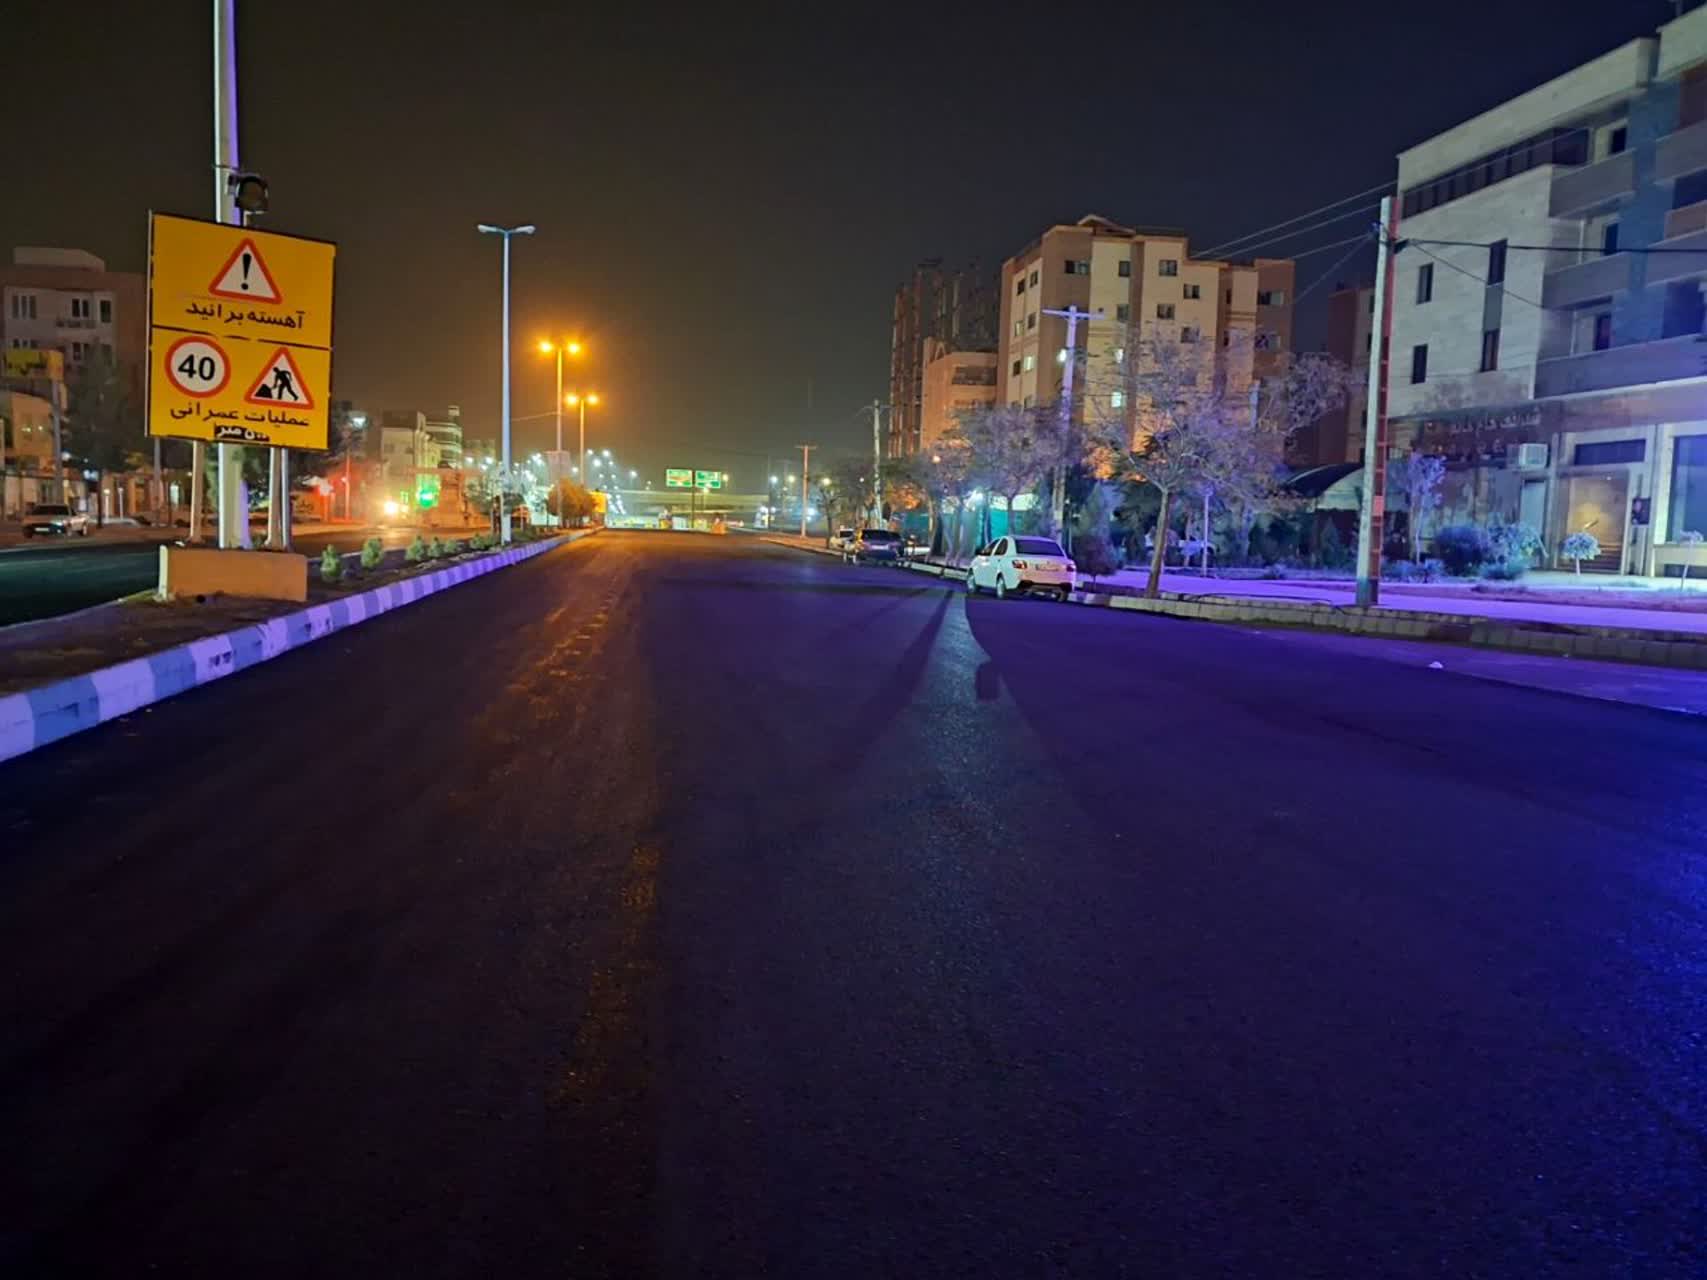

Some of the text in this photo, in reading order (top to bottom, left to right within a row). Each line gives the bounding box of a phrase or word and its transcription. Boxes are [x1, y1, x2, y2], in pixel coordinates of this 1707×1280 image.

[185, 302, 305, 329] آهسته برانید
[178, 354, 215, 381] 40
[170, 401, 309, 428] عملیات عمرانی
